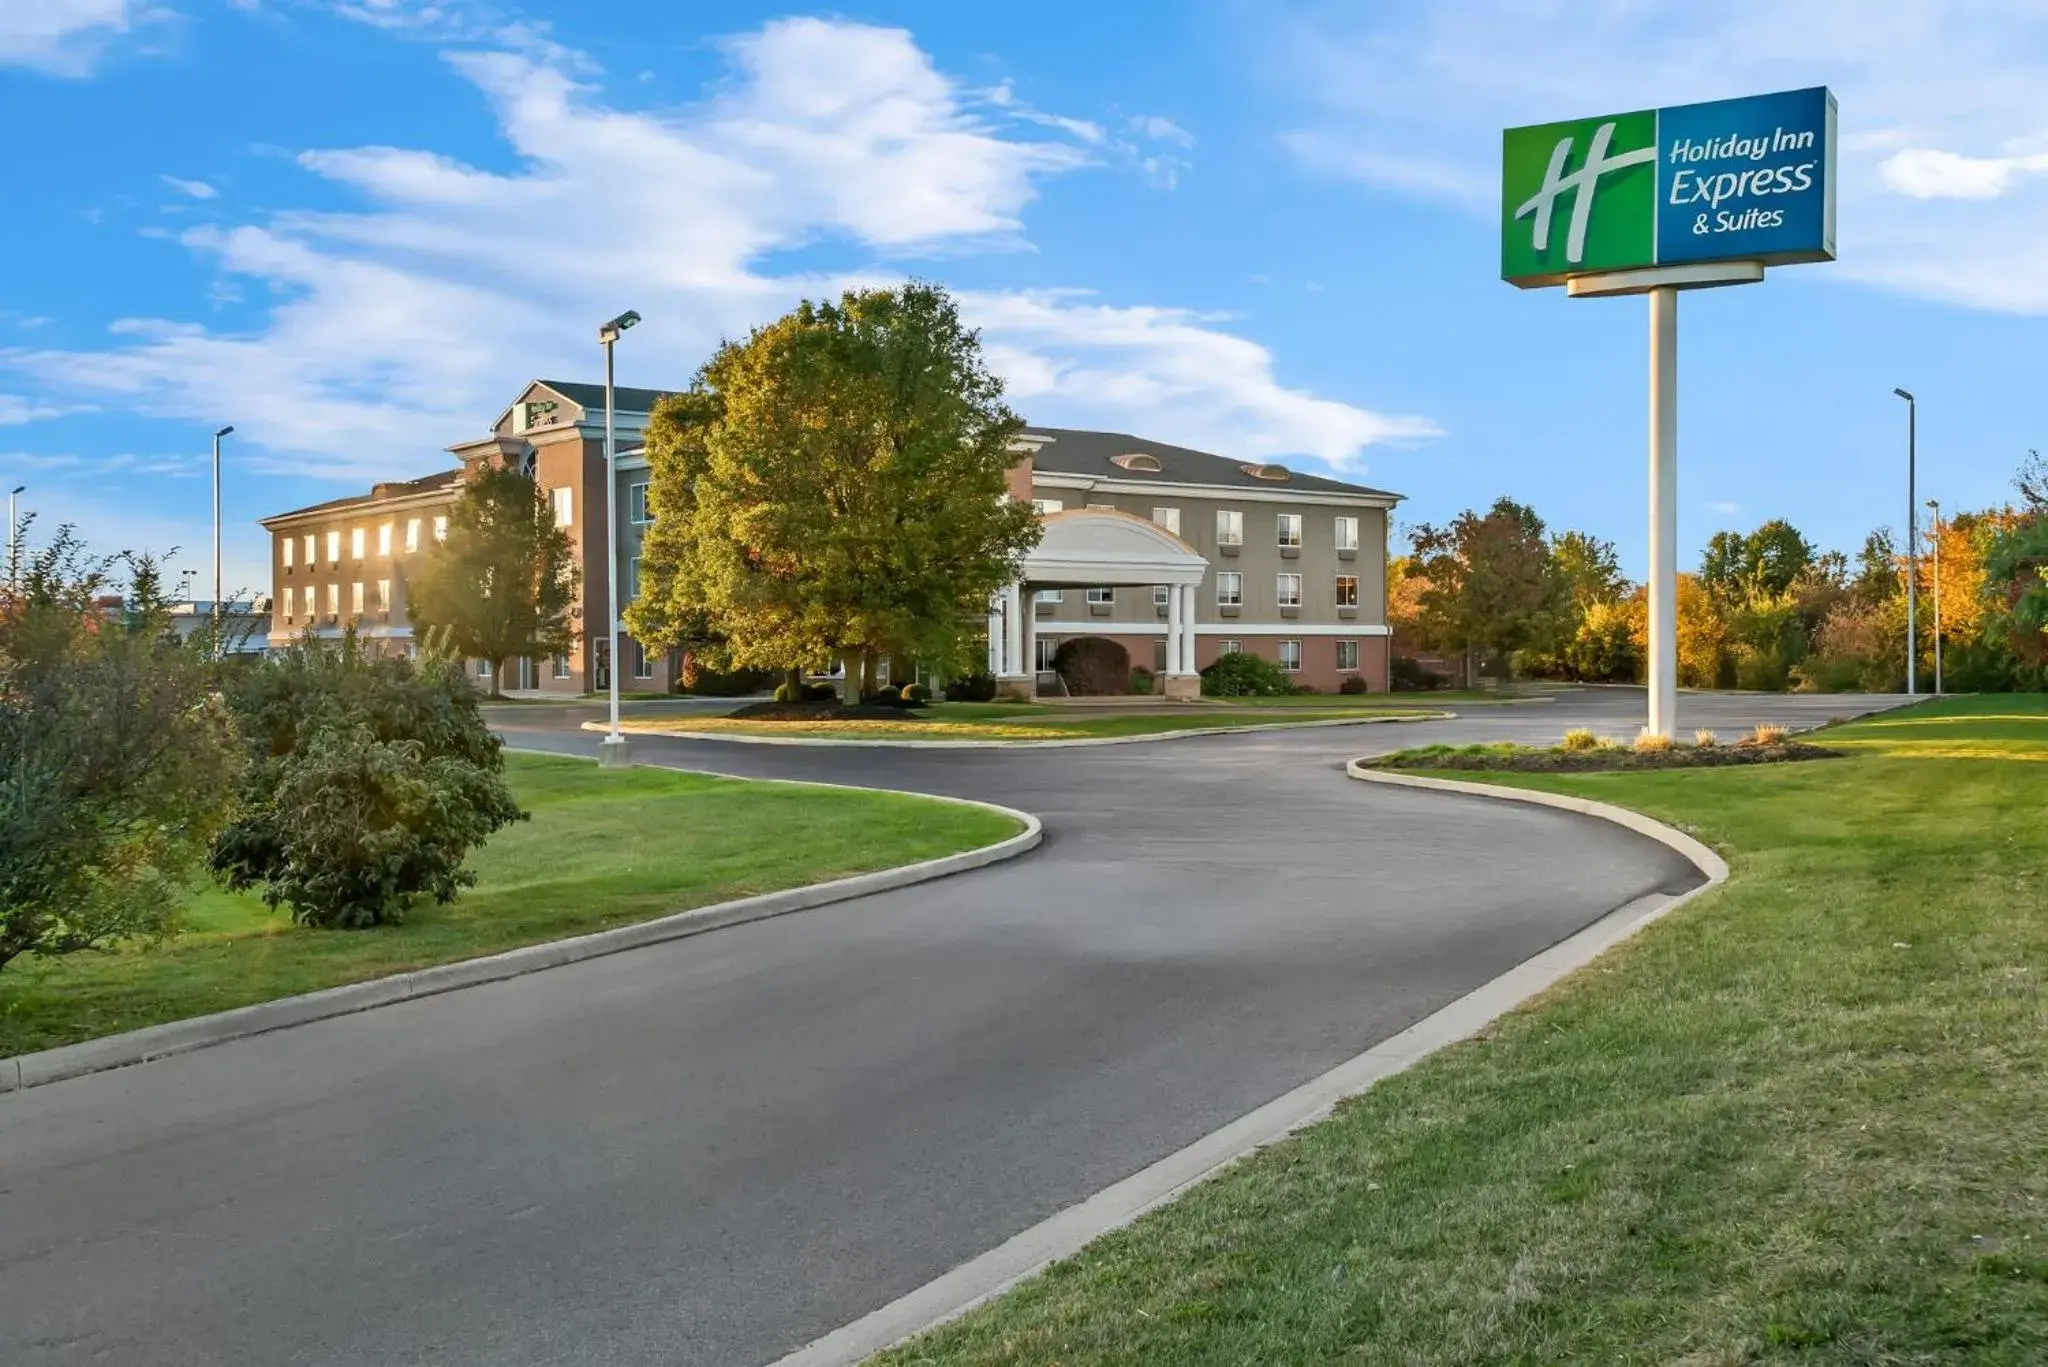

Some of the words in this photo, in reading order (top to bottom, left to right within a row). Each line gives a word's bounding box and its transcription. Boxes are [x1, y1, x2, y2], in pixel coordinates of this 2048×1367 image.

[1669, 132, 1767, 164] Holiday
[1772, 127, 1814, 153] Inn
[1669, 162, 1815, 209] Express
[1692, 212, 1709, 235] &
[1714, 208, 1784, 233] Suites
